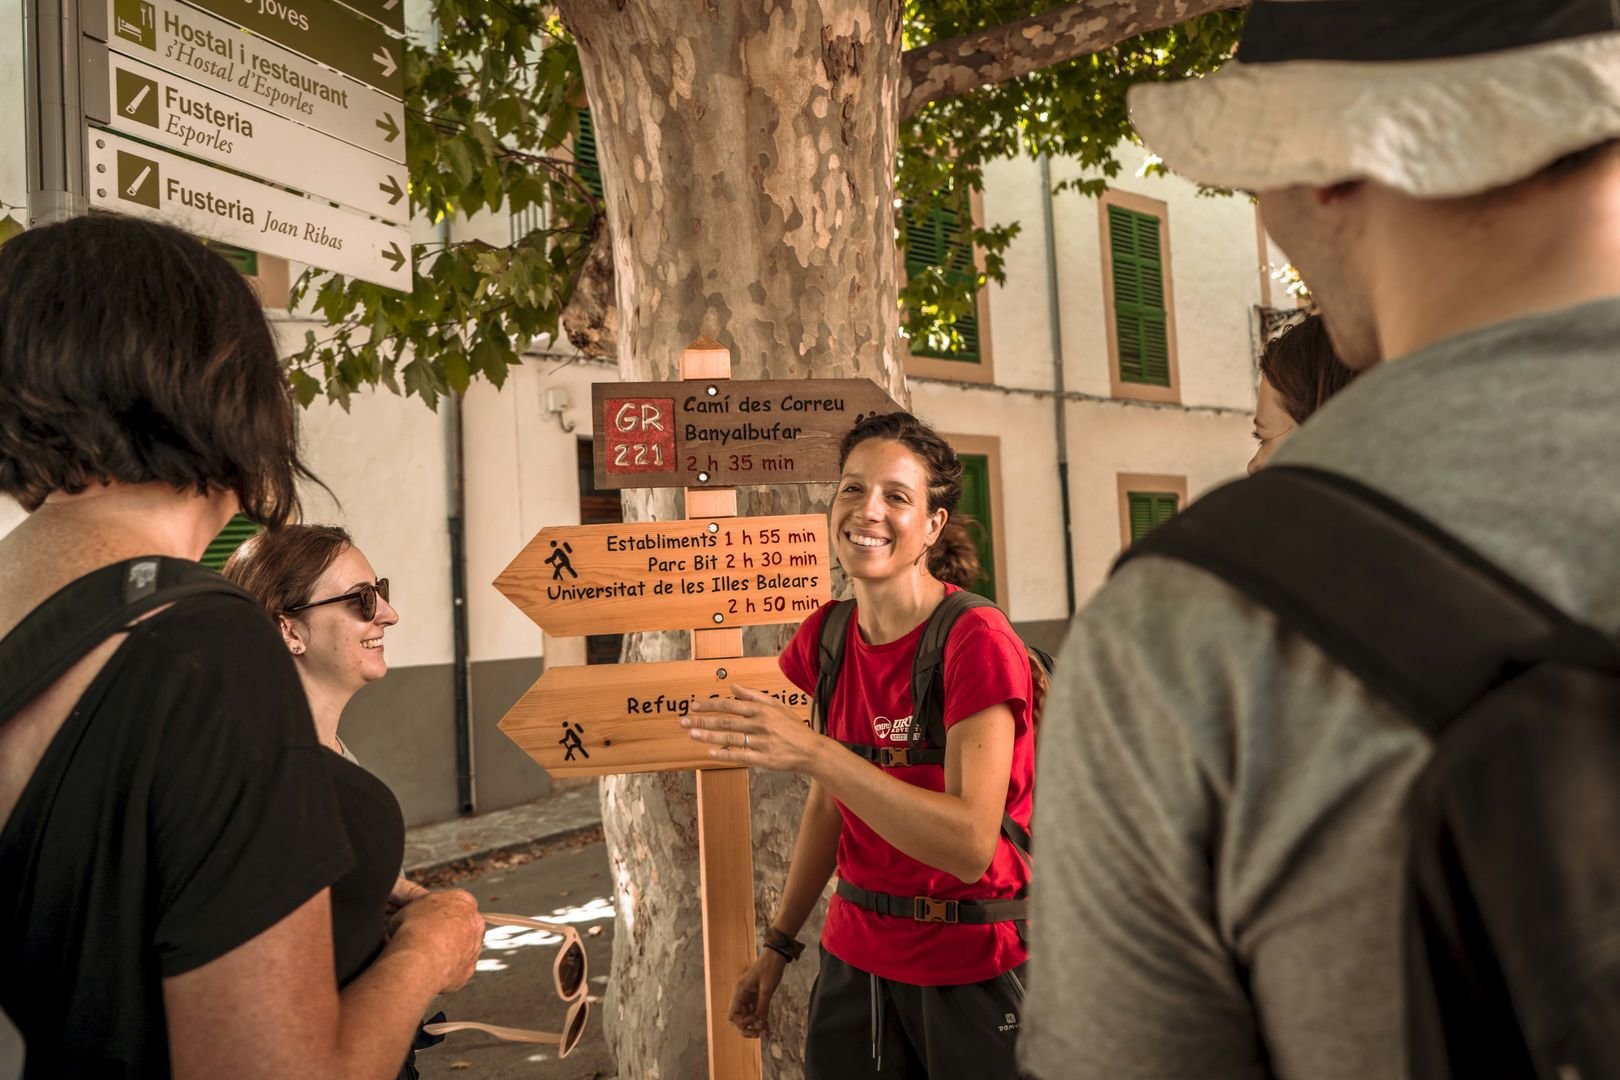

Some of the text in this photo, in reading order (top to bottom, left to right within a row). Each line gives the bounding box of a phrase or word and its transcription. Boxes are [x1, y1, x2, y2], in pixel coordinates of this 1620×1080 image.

[164, 10, 349, 109] Hostal i restaurant
[165, 39, 314, 115] s'Hostal d'Esporles
[165, 85, 253, 138] Fusteria
[165, 113, 234, 154] Esporles
[167, 178, 343, 250] Fusteria Joan Ribas
[683, 395, 845, 413] Camí des Correu
[615, 403, 664, 432] GR
[685, 422, 802, 446] Banyalbufar
[614, 444, 664, 466] 221
[686, 454, 794, 471] 2 h 35 min
[607, 528, 816, 552] Establiments 1 h 55 min
[648, 551, 817, 572] Parc Bit 2 h 30 min
[547, 573, 818, 600] Universitat de les Illes Balears
[728, 595, 820, 613] 2 h 50 min
